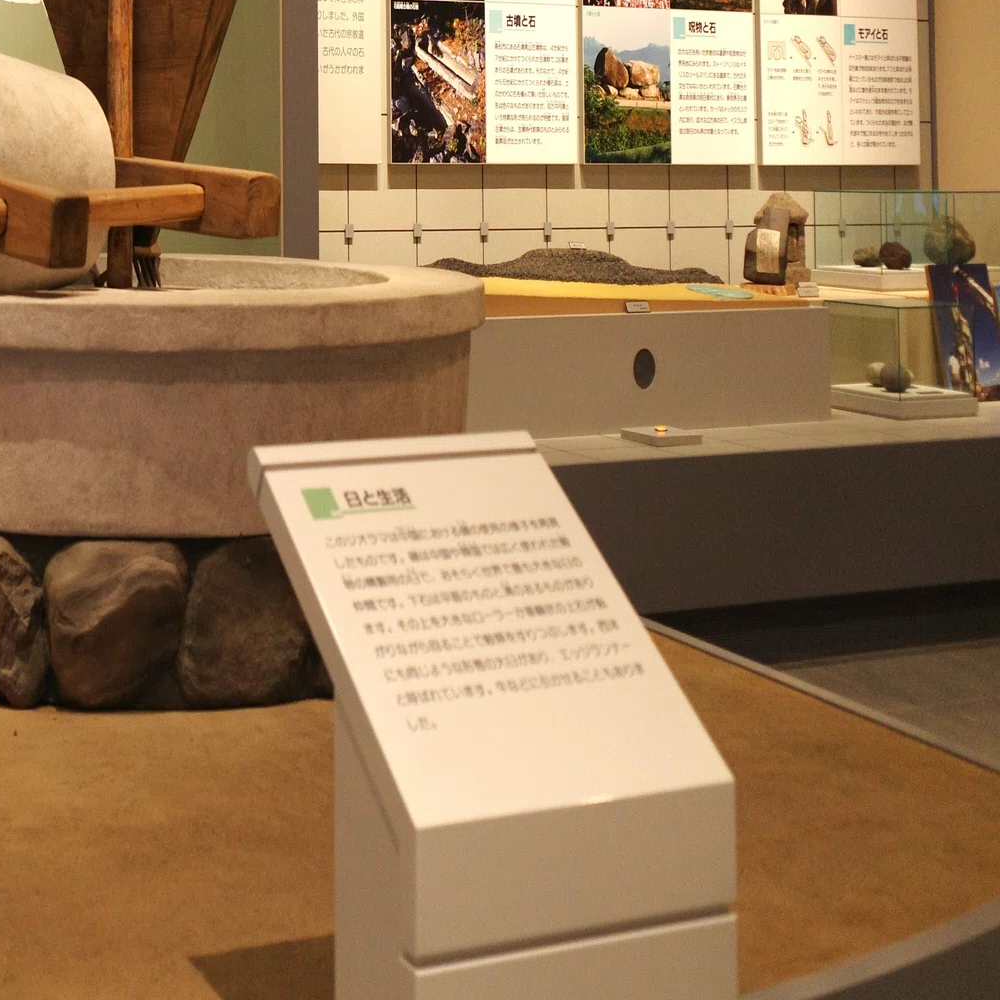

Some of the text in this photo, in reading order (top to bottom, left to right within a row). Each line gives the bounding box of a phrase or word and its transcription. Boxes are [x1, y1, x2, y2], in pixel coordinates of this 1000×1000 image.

[506, 14, 536, 28] 古墳と石
[858, 28, 888, 40] モアイと石
[343, 487, 412, 509] 臼と生活
